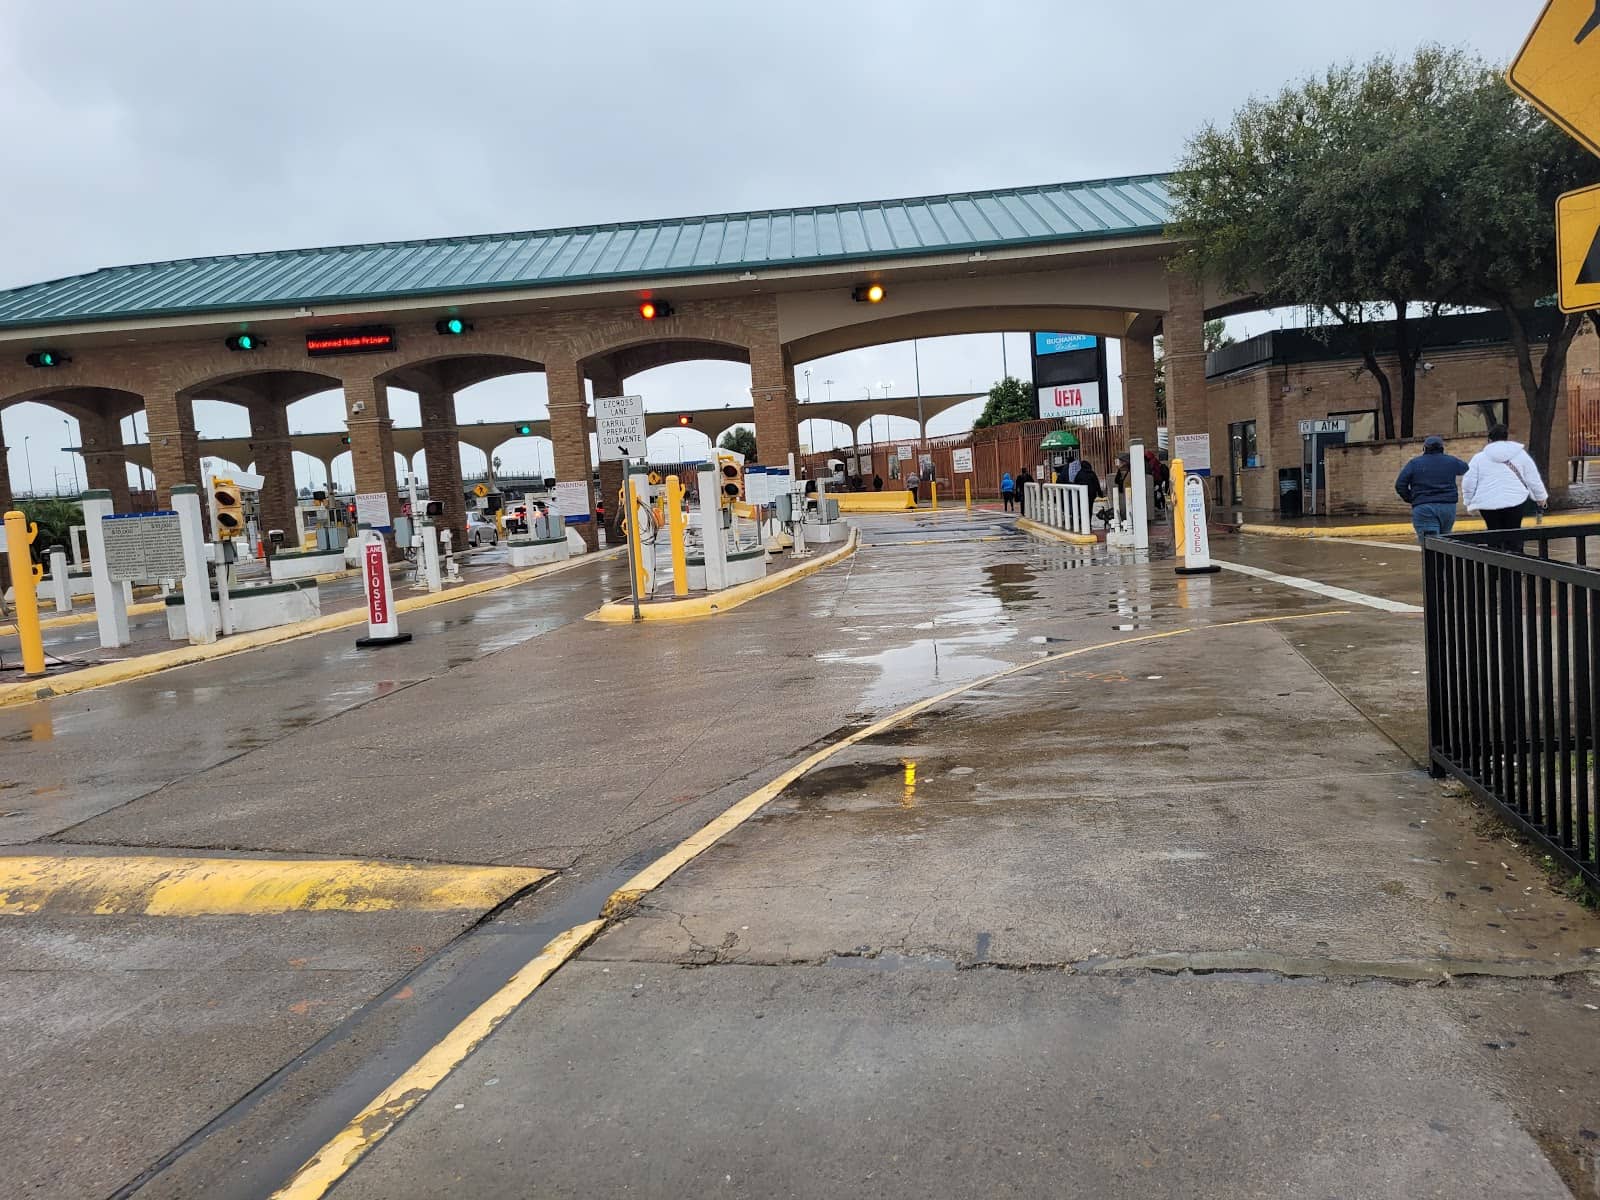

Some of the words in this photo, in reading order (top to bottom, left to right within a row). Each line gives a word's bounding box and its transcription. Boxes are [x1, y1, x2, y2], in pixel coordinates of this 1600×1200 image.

[1055, 387, 1082, 406] UETA
[610, 407, 629, 416] LANE
[601, 419, 625, 428] CARRIL
[630, 417, 640, 426] DE
[1321, 420, 1339, 431] ATM
[606, 426, 636, 436] PREPAGO
[602, 434, 642, 445] SOLAMENTE
[1192, 513, 1202, 553] CLOSED
[371, 554, 383, 622] CLOSED
